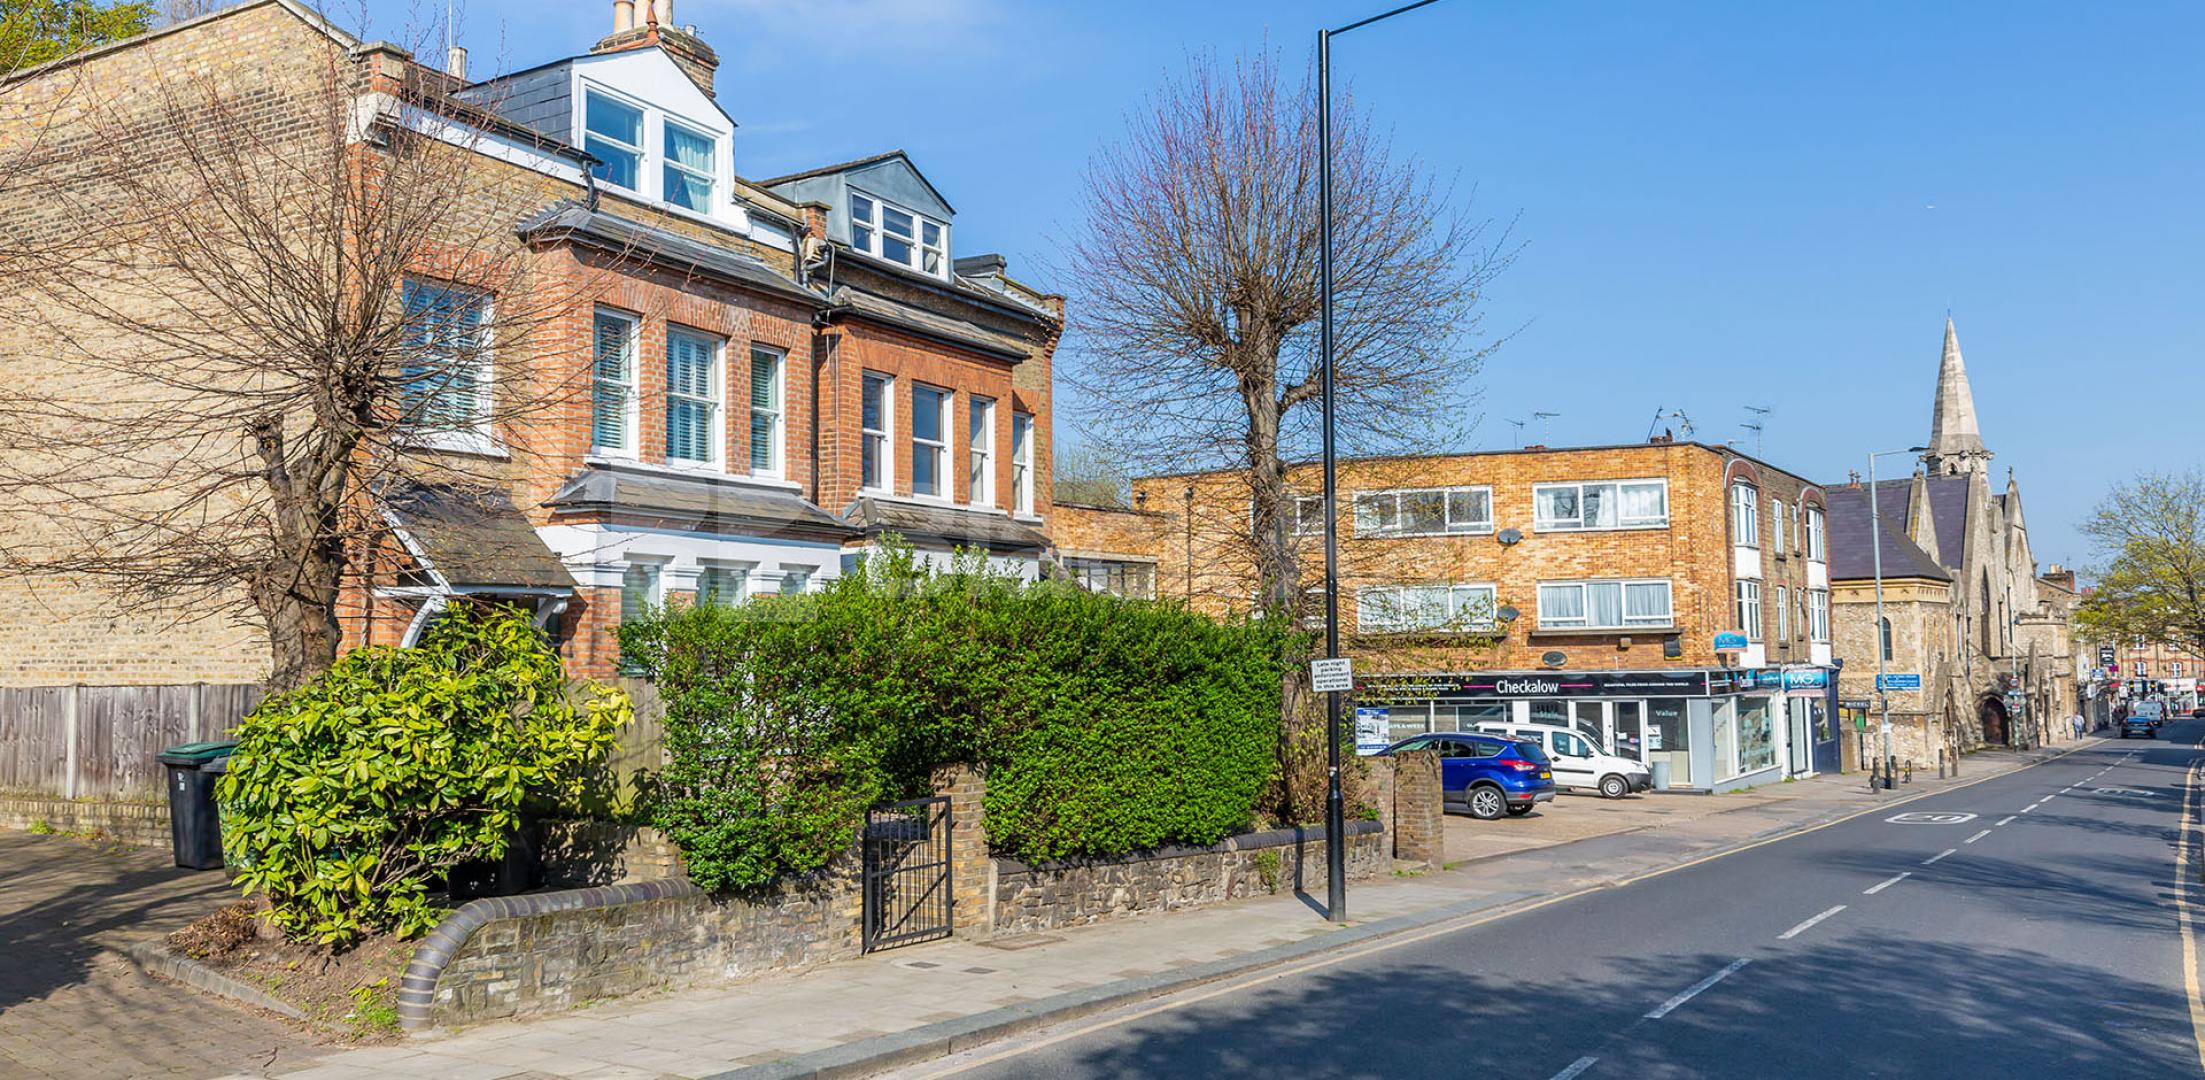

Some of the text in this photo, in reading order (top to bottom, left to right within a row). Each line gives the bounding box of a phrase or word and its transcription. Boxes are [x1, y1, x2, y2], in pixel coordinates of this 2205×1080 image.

[1790, 673, 1814, 684] MG
[1496, 679, 1559, 694] Checkalow
[1655, 709, 1678, 717] Value
